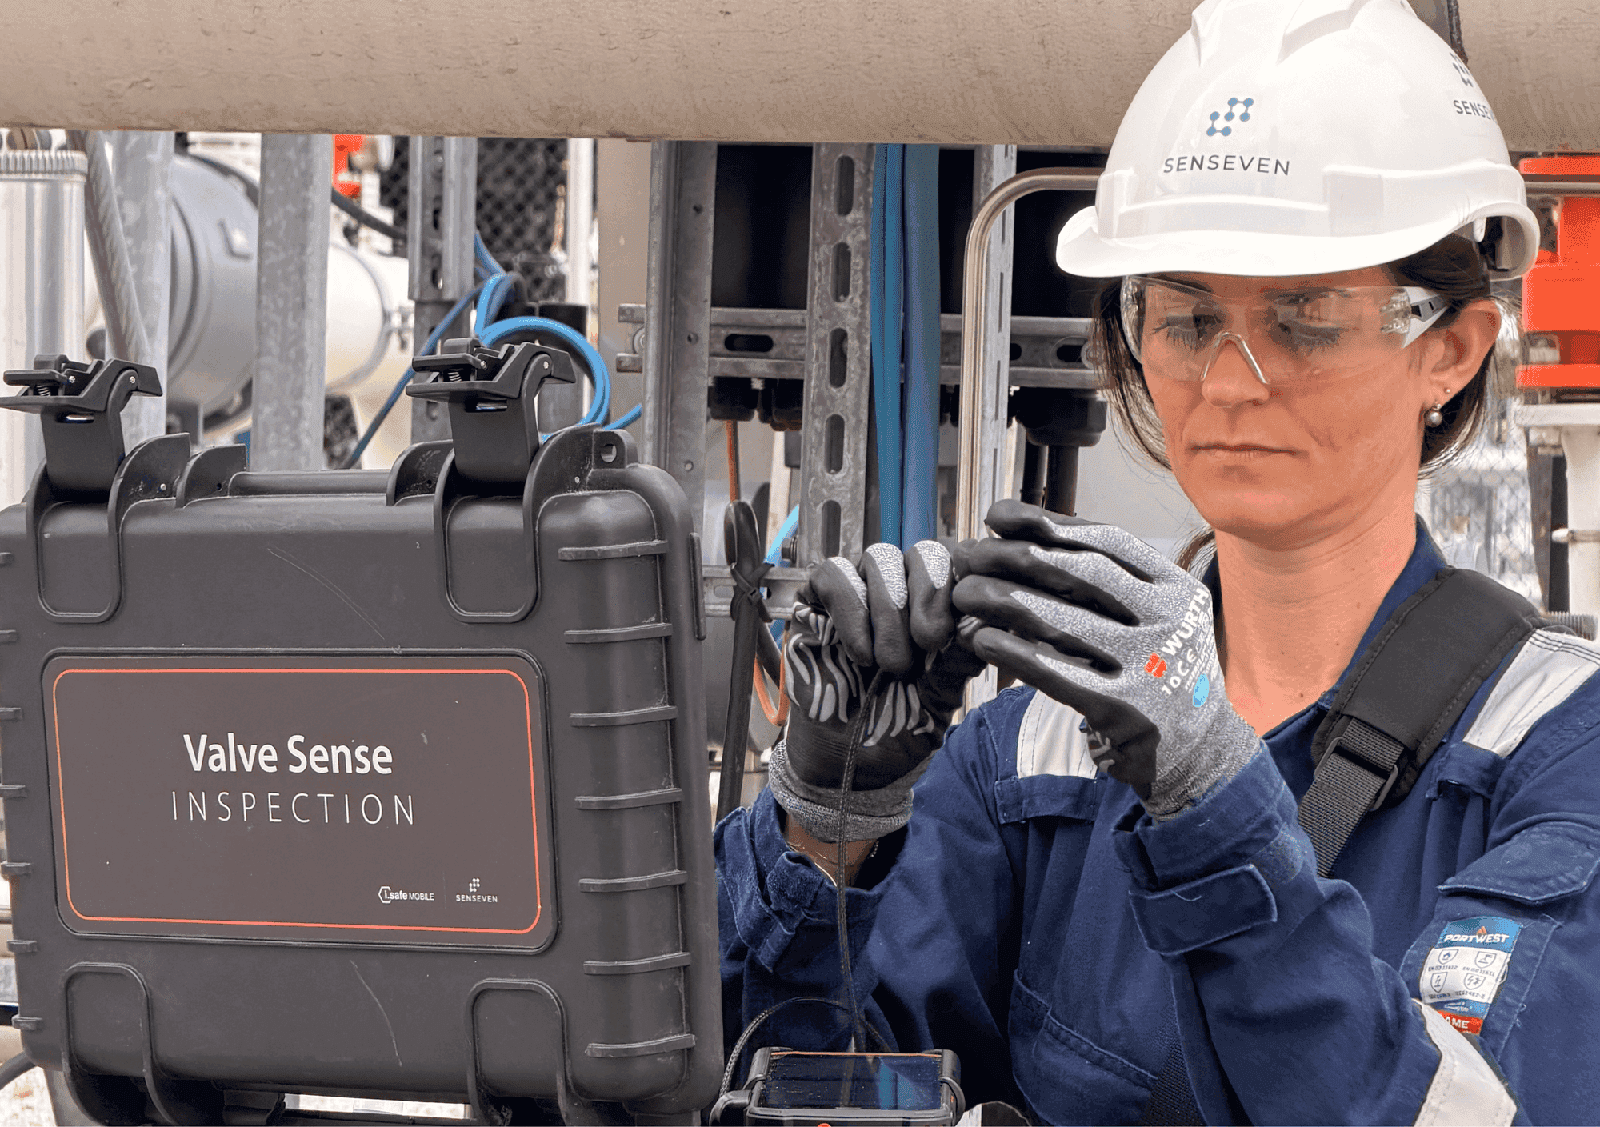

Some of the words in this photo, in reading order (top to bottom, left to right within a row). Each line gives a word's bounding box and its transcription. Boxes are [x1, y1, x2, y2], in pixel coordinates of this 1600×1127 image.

[1163, 154, 1290, 176] SENSEVEN
[183, 732, 278, 773] Valve
[287, 734, 393, 774] Sense
[172, 791, 413, 825] INSPECTION
[455, 893, 499, 903] SENSEVEN
[1443, 932, 1510, 944] PORTWEST
